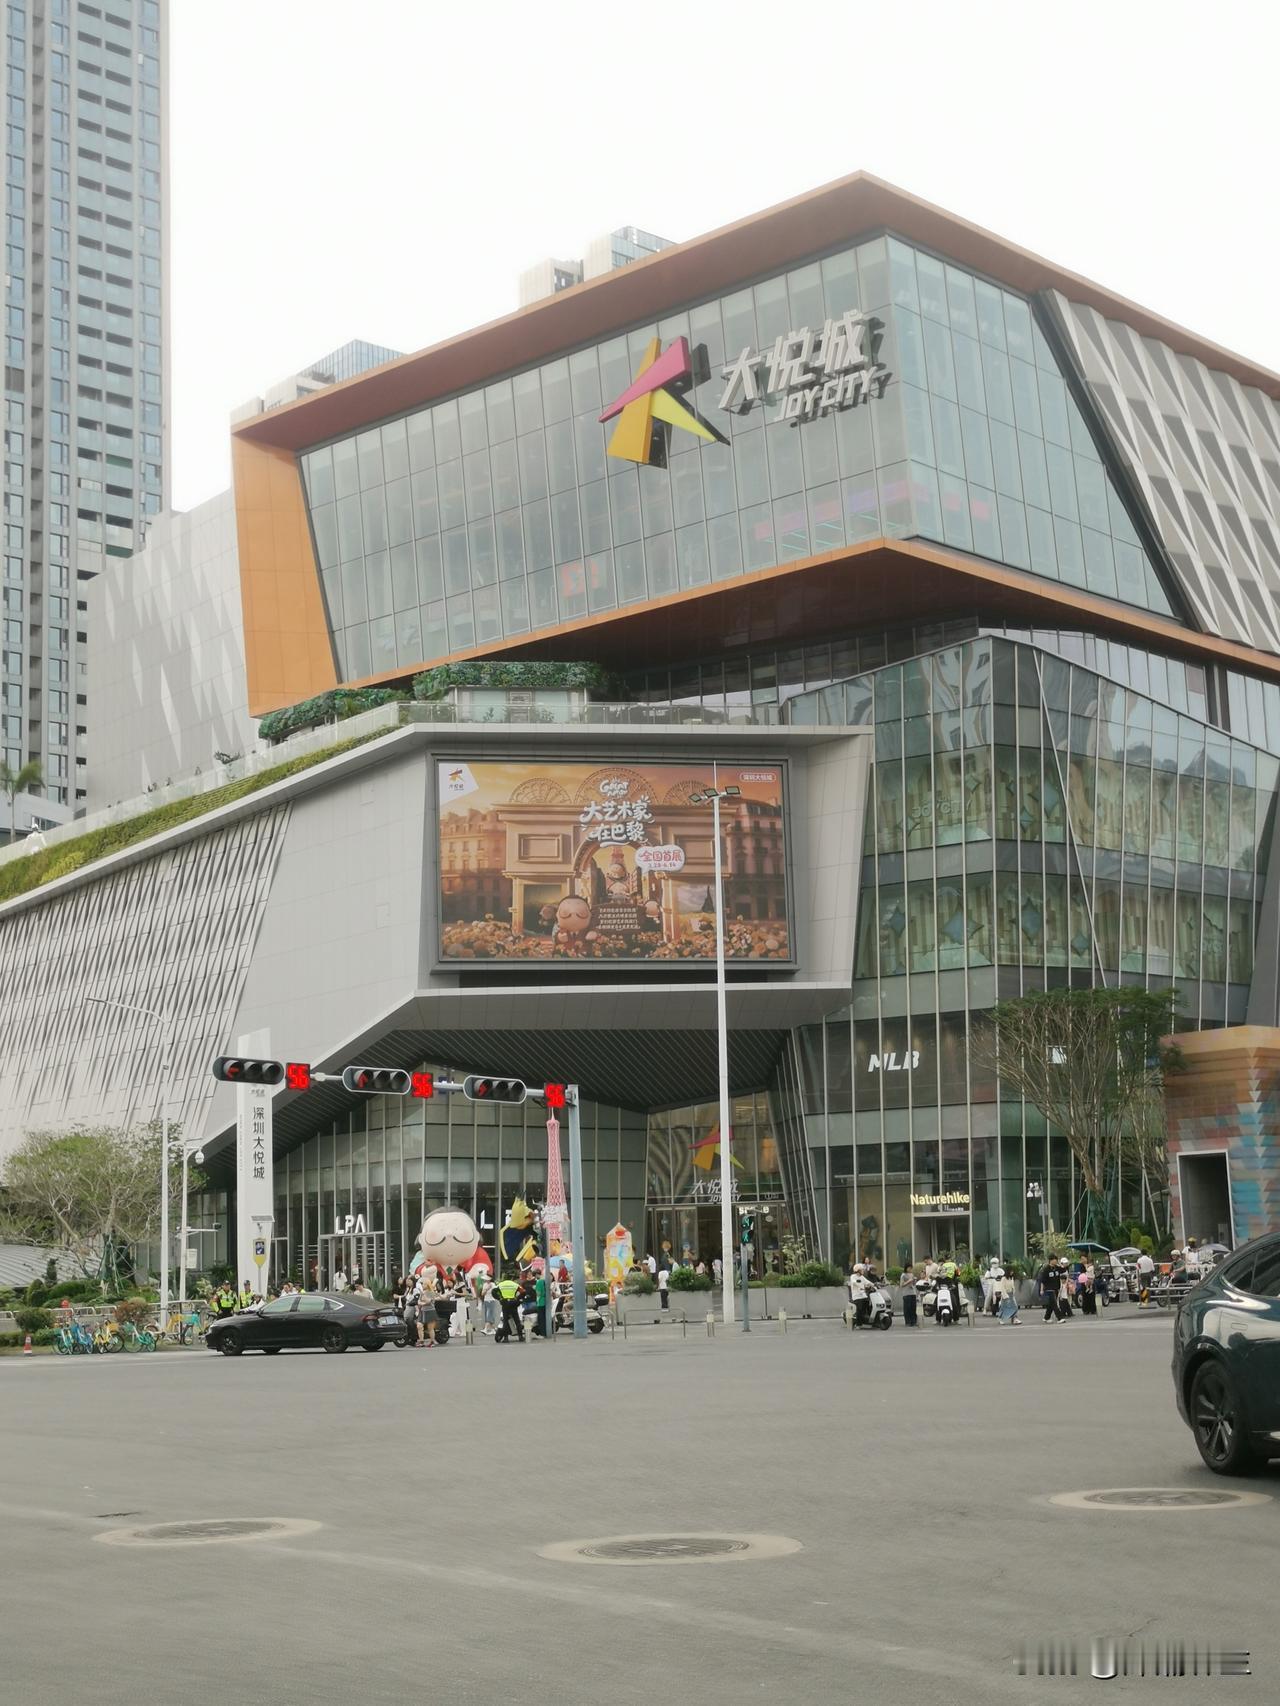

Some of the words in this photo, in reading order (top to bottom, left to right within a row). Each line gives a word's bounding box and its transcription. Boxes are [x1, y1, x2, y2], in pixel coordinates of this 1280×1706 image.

[718, 309, 867, 410] 大悦城
[580, 799, 653, 822] 大艺术家
[586, 821, 646, 842] 在巴黎
[640, 850, 681, 862] 全国首展
[867, 1050, 920, 1072] MLB
[253, 1106, 265, 1180] 深圳大悦城
[910, 1191, 970, 1206] Naturehike
